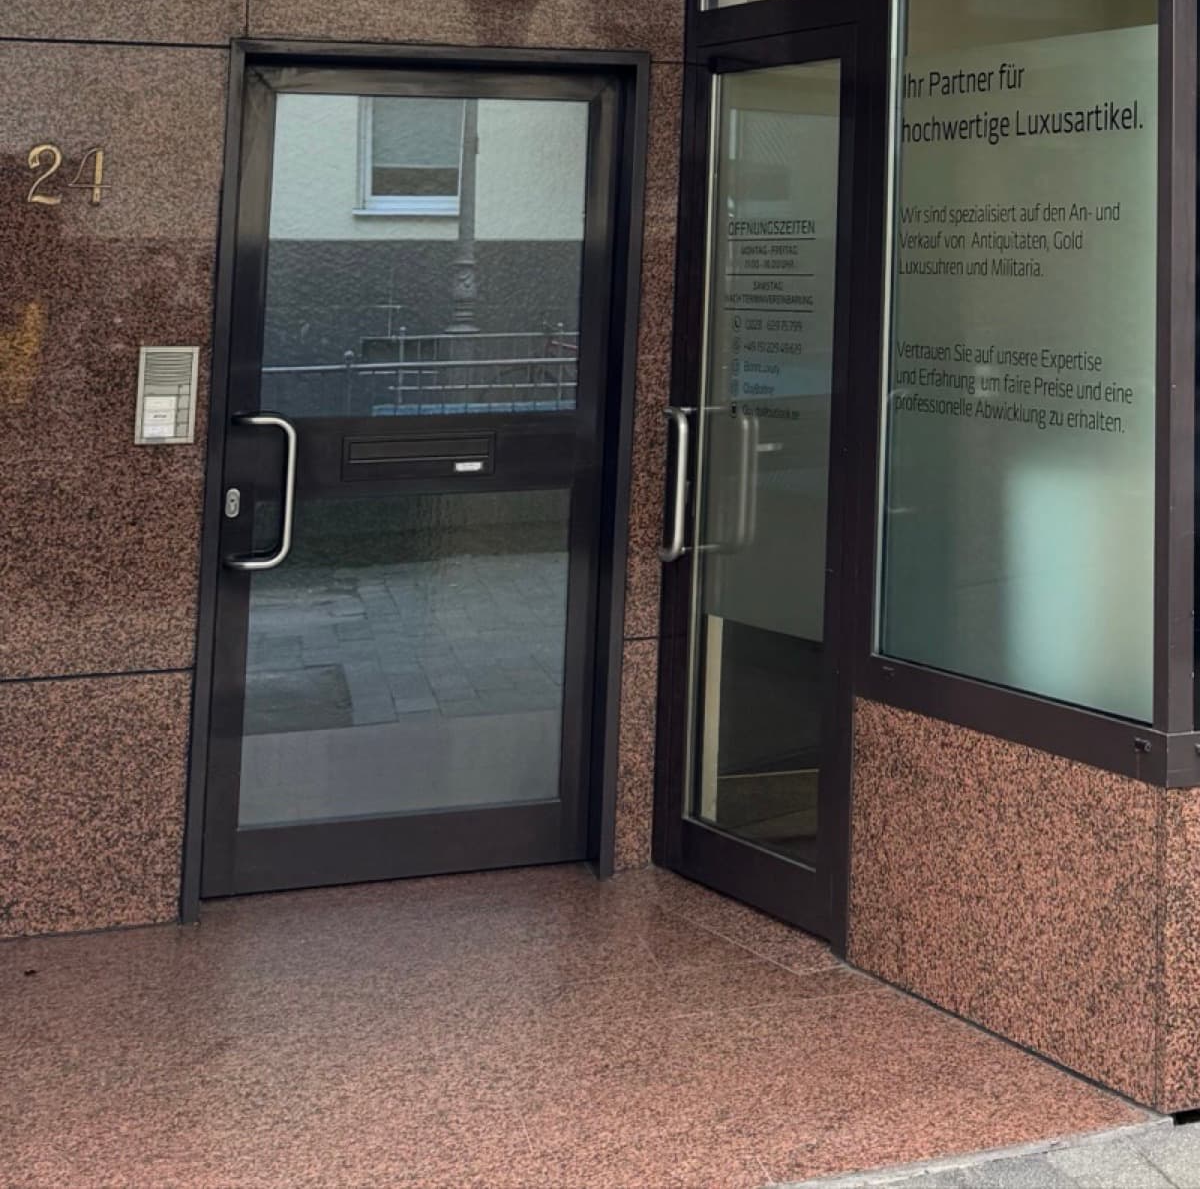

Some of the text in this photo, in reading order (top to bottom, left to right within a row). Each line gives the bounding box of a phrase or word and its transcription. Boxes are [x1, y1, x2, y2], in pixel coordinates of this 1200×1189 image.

[902, 63, 1025, 99] Ihr Partner für
[901, 100, 1144, 145] hochwertige Luxusartikel.
[27, 143, 111, 205] 24
[900, 201, 1120, 226] Wir sind spezialisiert auf den An- und
[899, 231, 942, 250] Verkauf
[944, 234, 966, 250] von
[1054, 230, 1084, 250] Gold
[899, 257, 1044, 277] Luxusuhren und Militaria.
[896, 341, 1102, 374] Vertrauen Sie auf unsere Expertise
[896, 367, 1133, 404] und Erfahrung um faire Preise und eine
[895, 393, 1126, 434] professionelle Abwicklung zu erhalten.
